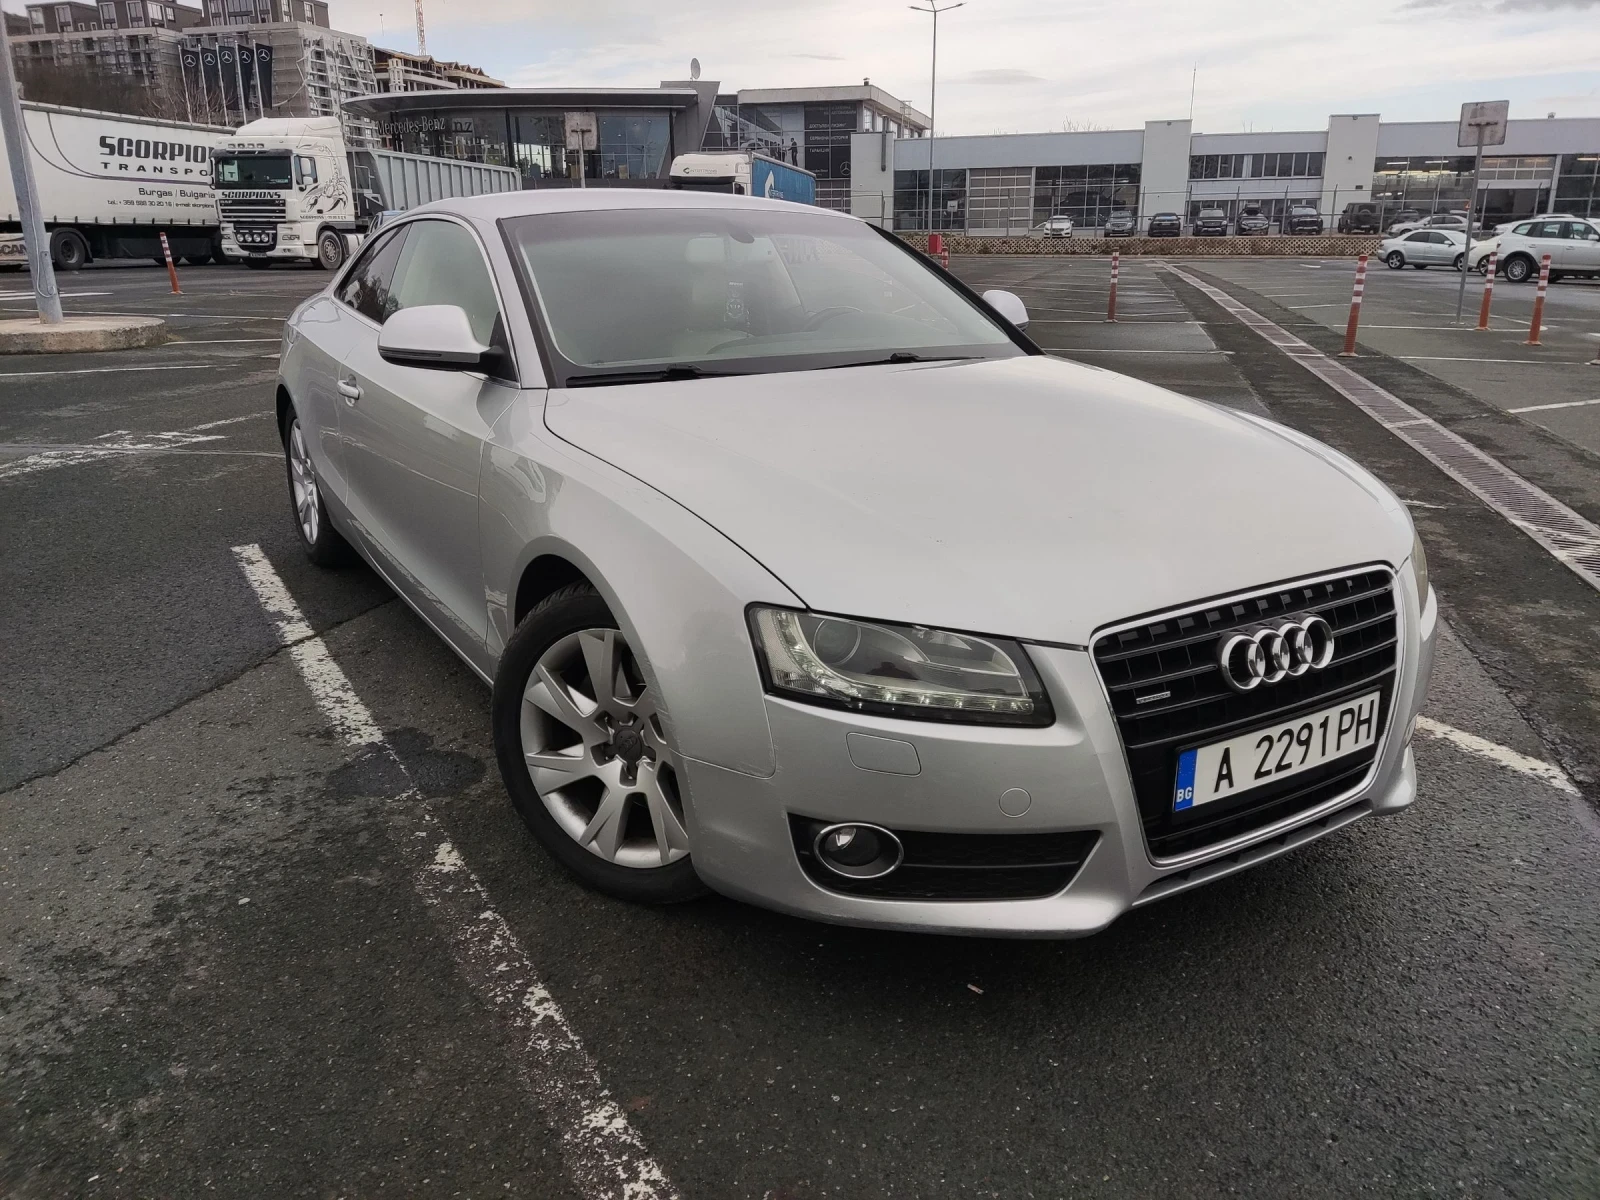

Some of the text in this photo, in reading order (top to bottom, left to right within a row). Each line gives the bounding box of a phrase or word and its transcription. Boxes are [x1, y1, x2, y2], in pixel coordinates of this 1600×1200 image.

[377, 116, 446, 135] Mercedes-Benz
[138, 187, 173, 198] Burgas
[179, 189, 216, 200] Bulgaria
[221, 191, 282, 199] SCORPIONS
[1213, 746, 1235, 793] A
[1254, 715, 1330, 781] 2291
[1176, 786, 1193, 803] BG
